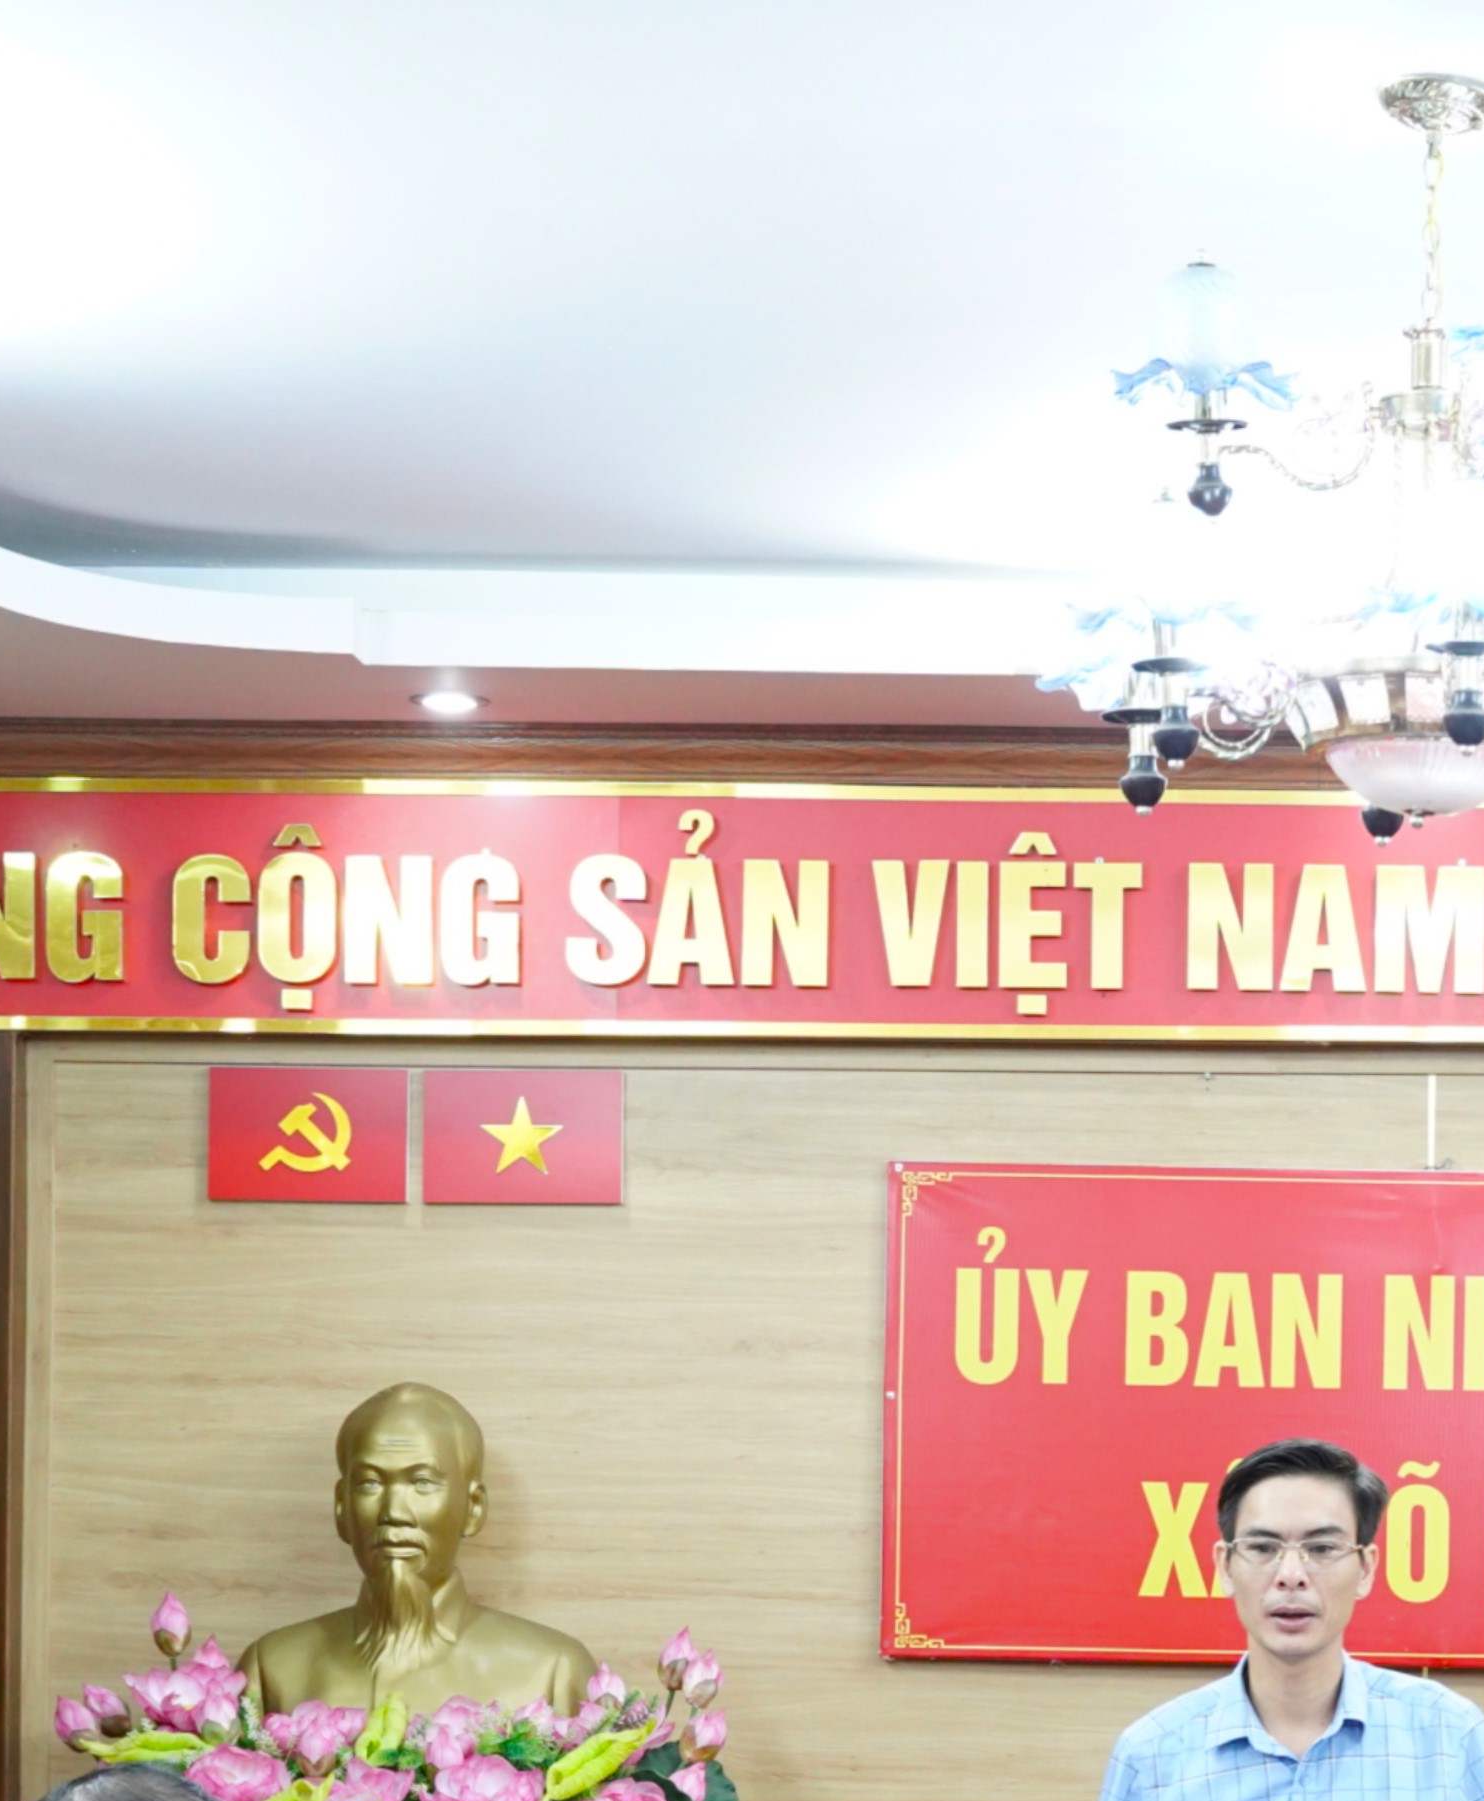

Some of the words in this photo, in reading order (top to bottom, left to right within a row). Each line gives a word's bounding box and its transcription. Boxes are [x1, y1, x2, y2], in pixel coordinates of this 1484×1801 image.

[170, 823, 520, 1011] CỘNG
[565, 808, 832, 989] SẢN
[870, 830, 1145, 1015] VIỆT
[954, 1226, 1089, 1386] ỦY
[1124, 1270, 1345, 1389] BAN
[1137, 1458, 1244, 1599] X
[1383, 1460, 1452, 1603] Õ
